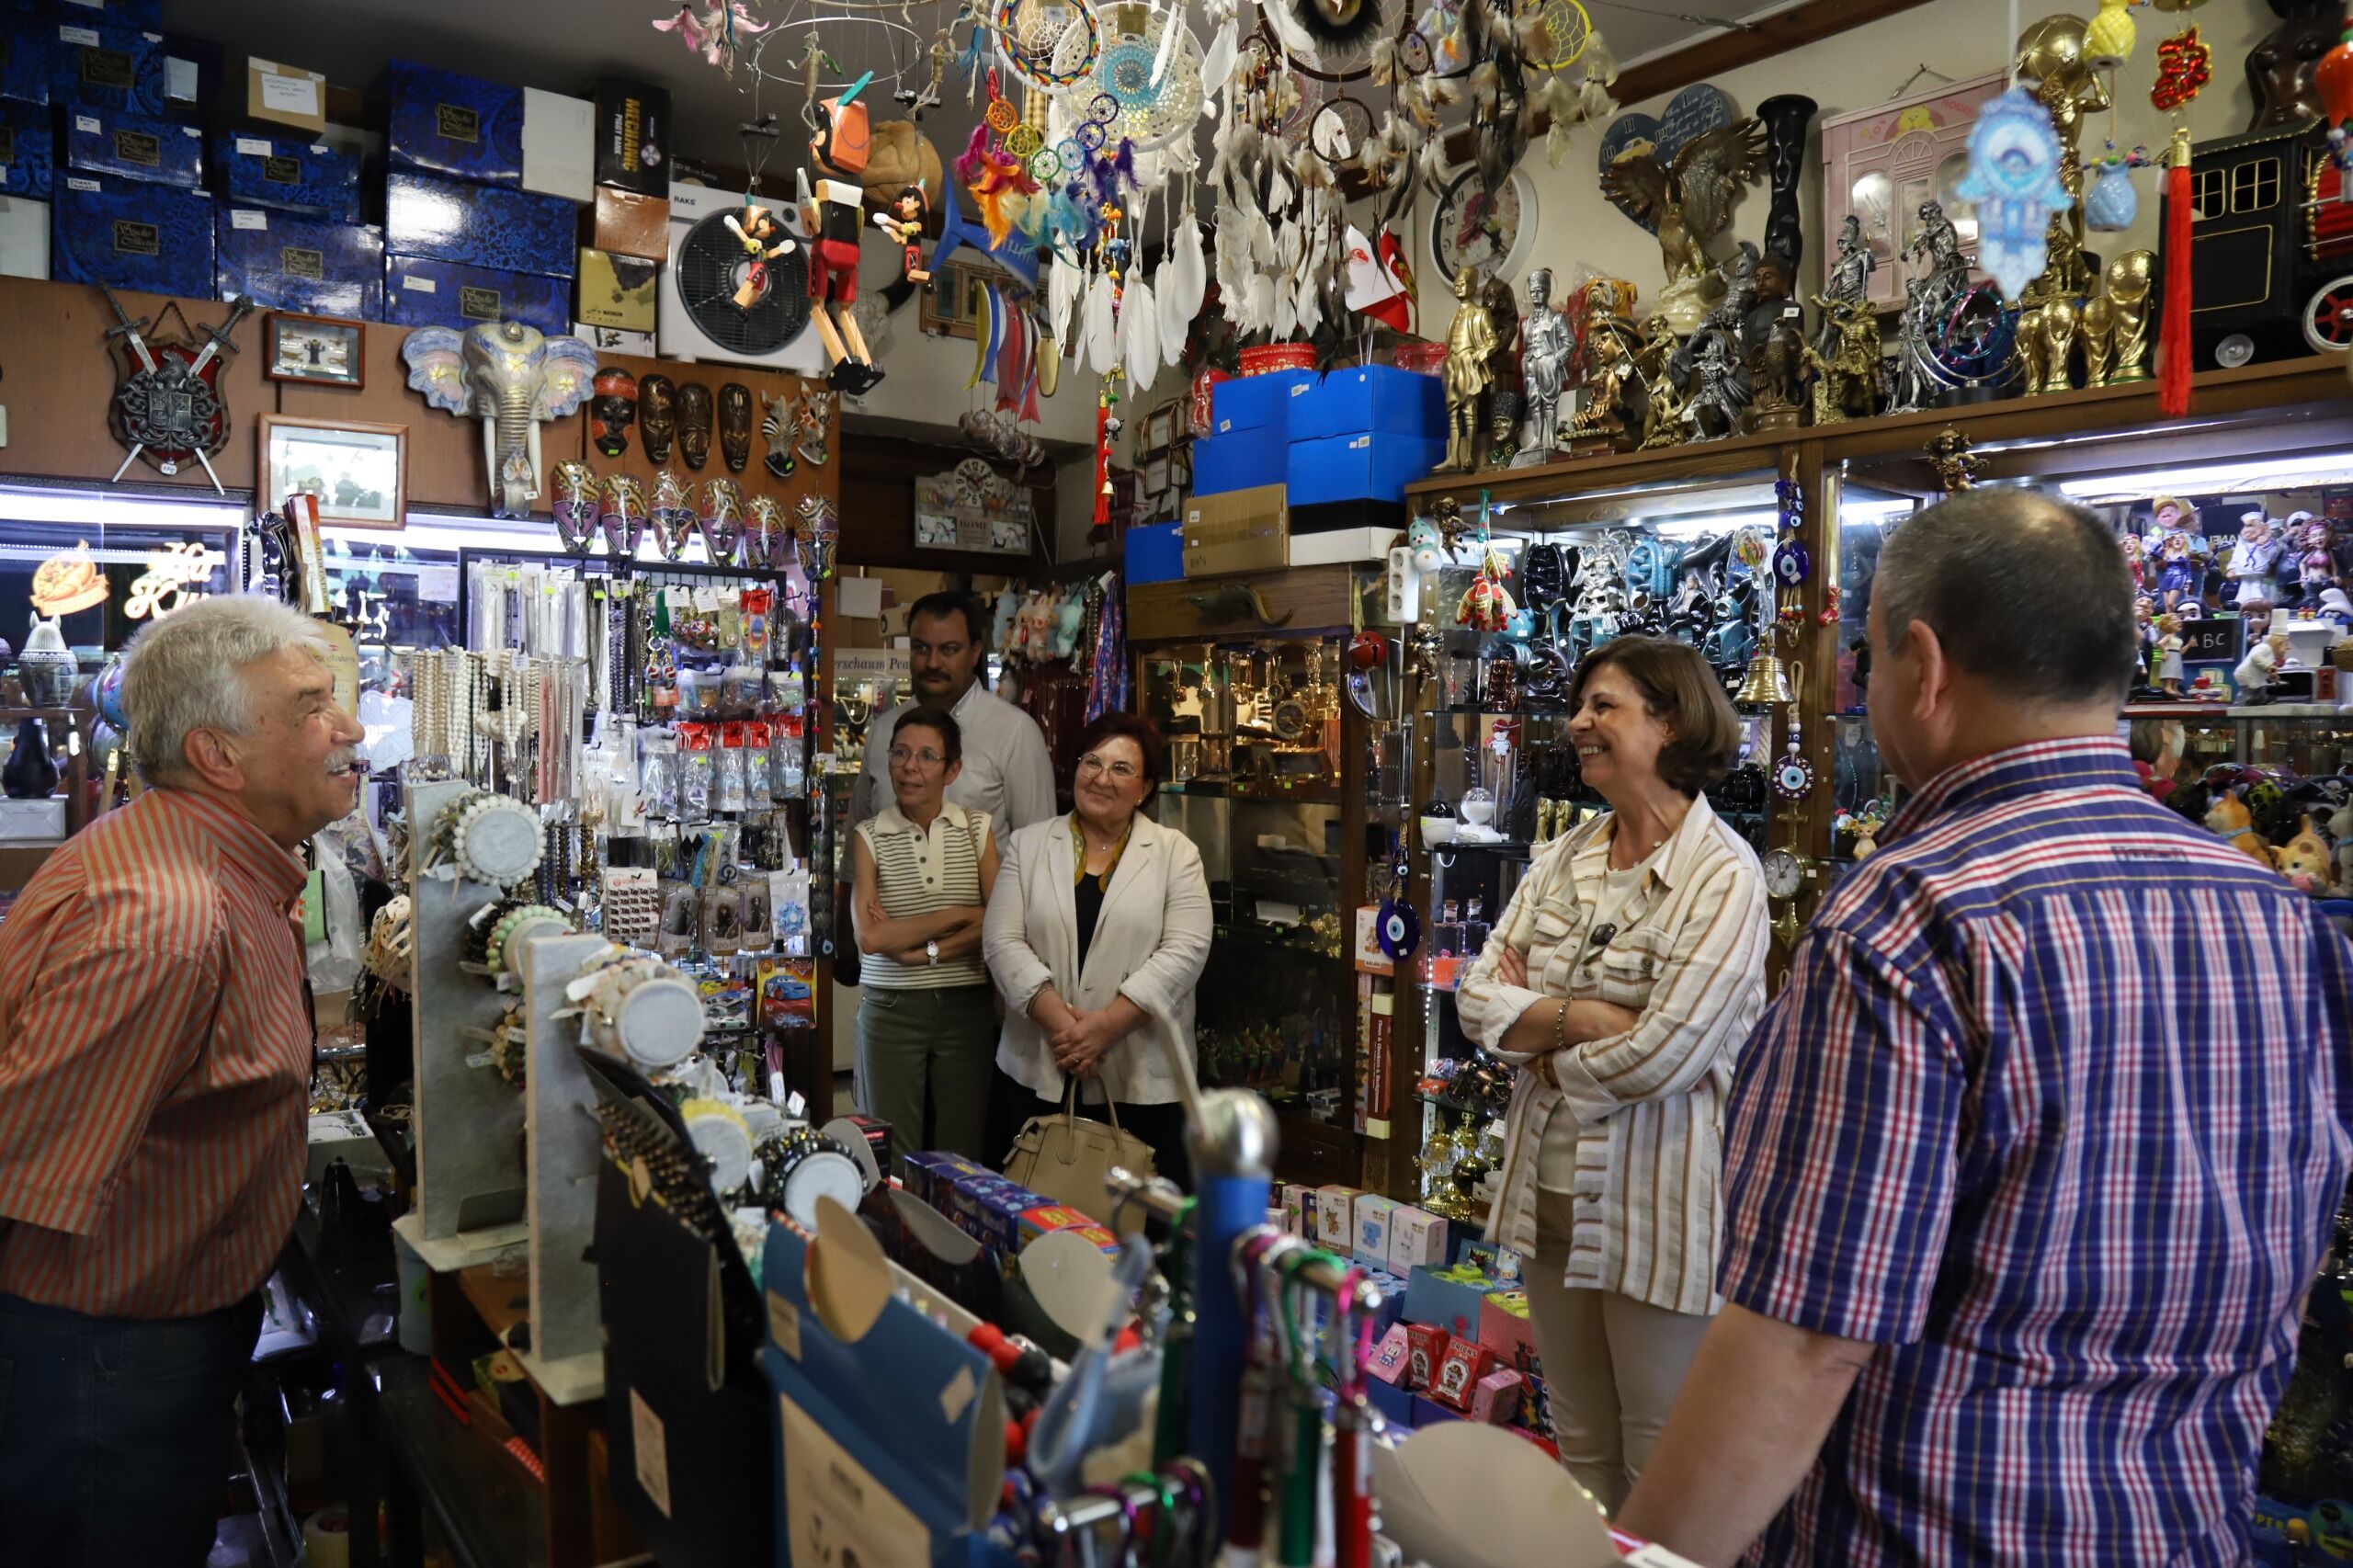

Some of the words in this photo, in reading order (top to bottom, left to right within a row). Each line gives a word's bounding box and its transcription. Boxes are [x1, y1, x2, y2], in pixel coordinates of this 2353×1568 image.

[1712, 97, 1723, 112] 2
[1624, 118, 1637, 134] 11
[622, 97, 642, 173] MECHANIC
[674, 196, 696, 206] RAKS
[1449, 1339, 1478, 1358] BRICKS
